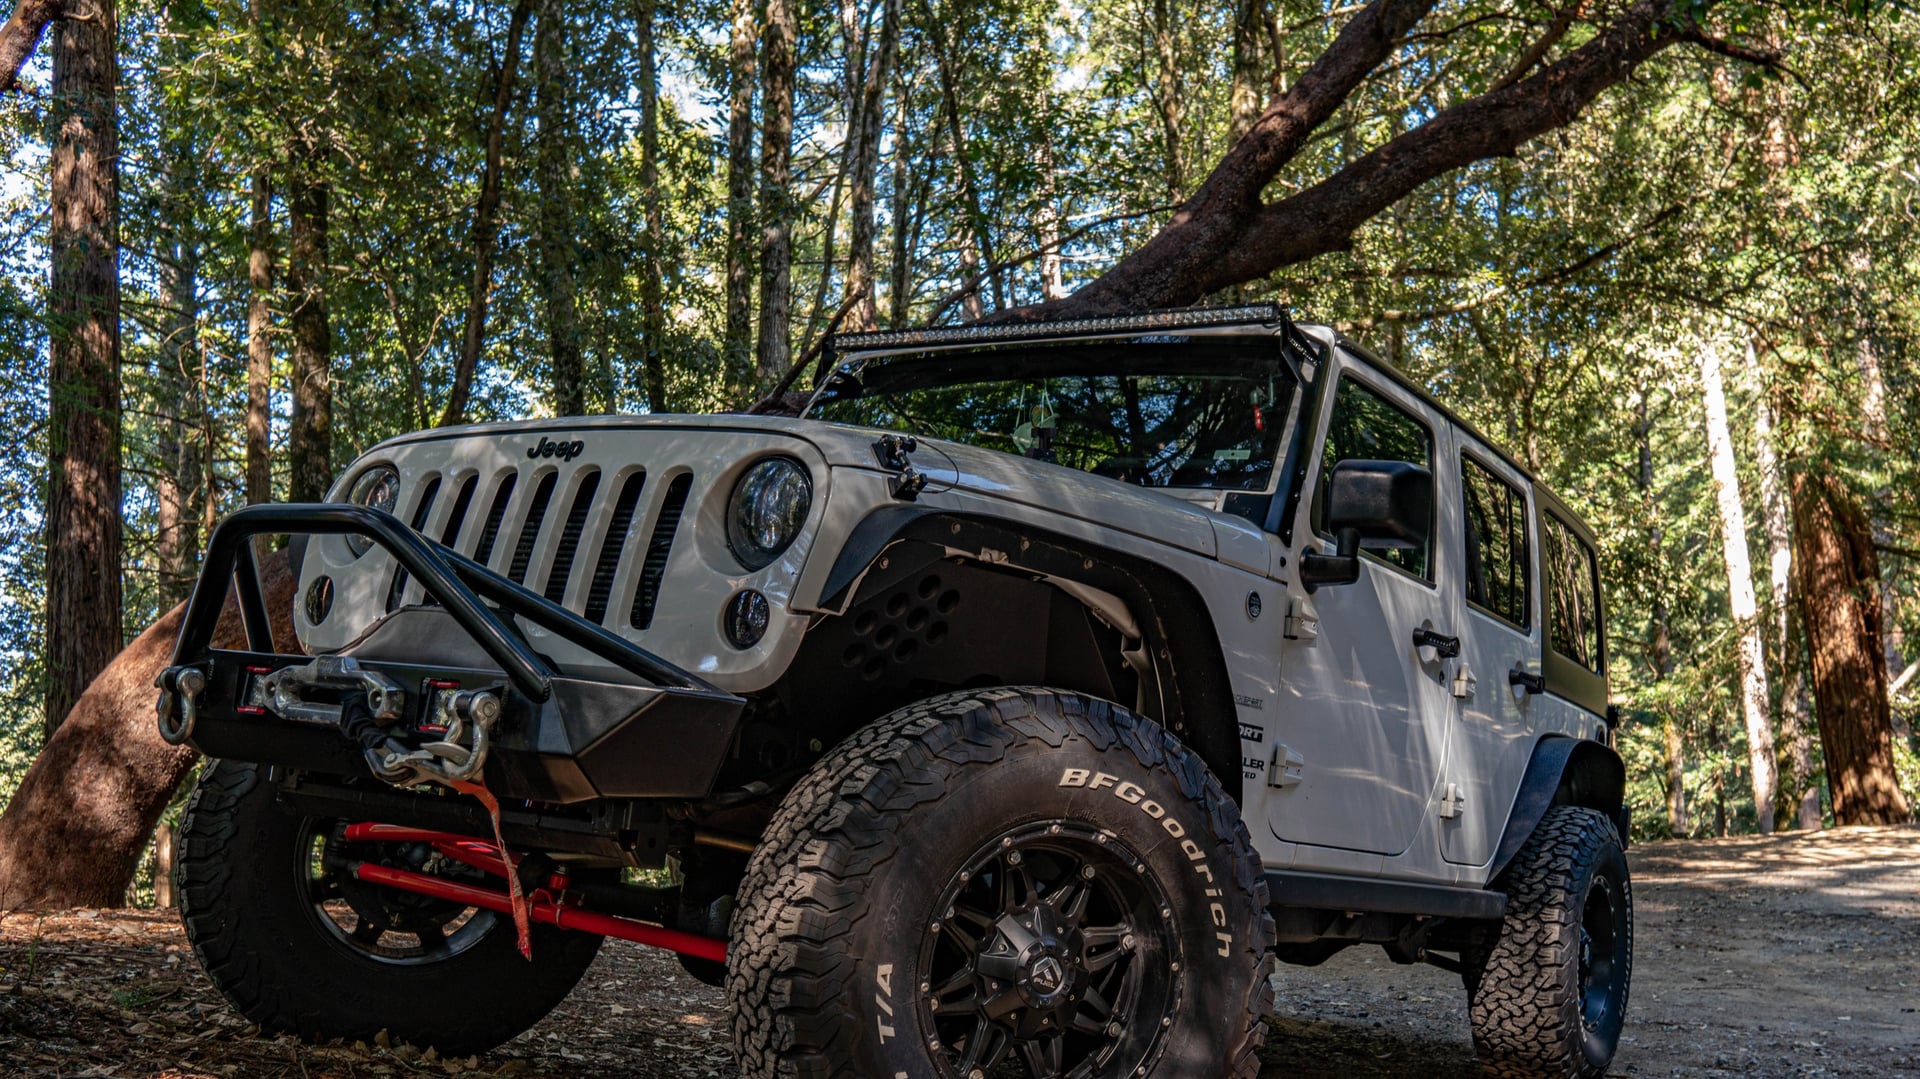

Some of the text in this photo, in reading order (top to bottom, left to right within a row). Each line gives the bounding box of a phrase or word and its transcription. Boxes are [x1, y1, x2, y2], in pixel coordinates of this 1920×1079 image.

[527, 436, 584, 462] Jeep
[1059, 768, 1233, 958] BFGoodrich
[875, 963, 896, 1045] T/A
